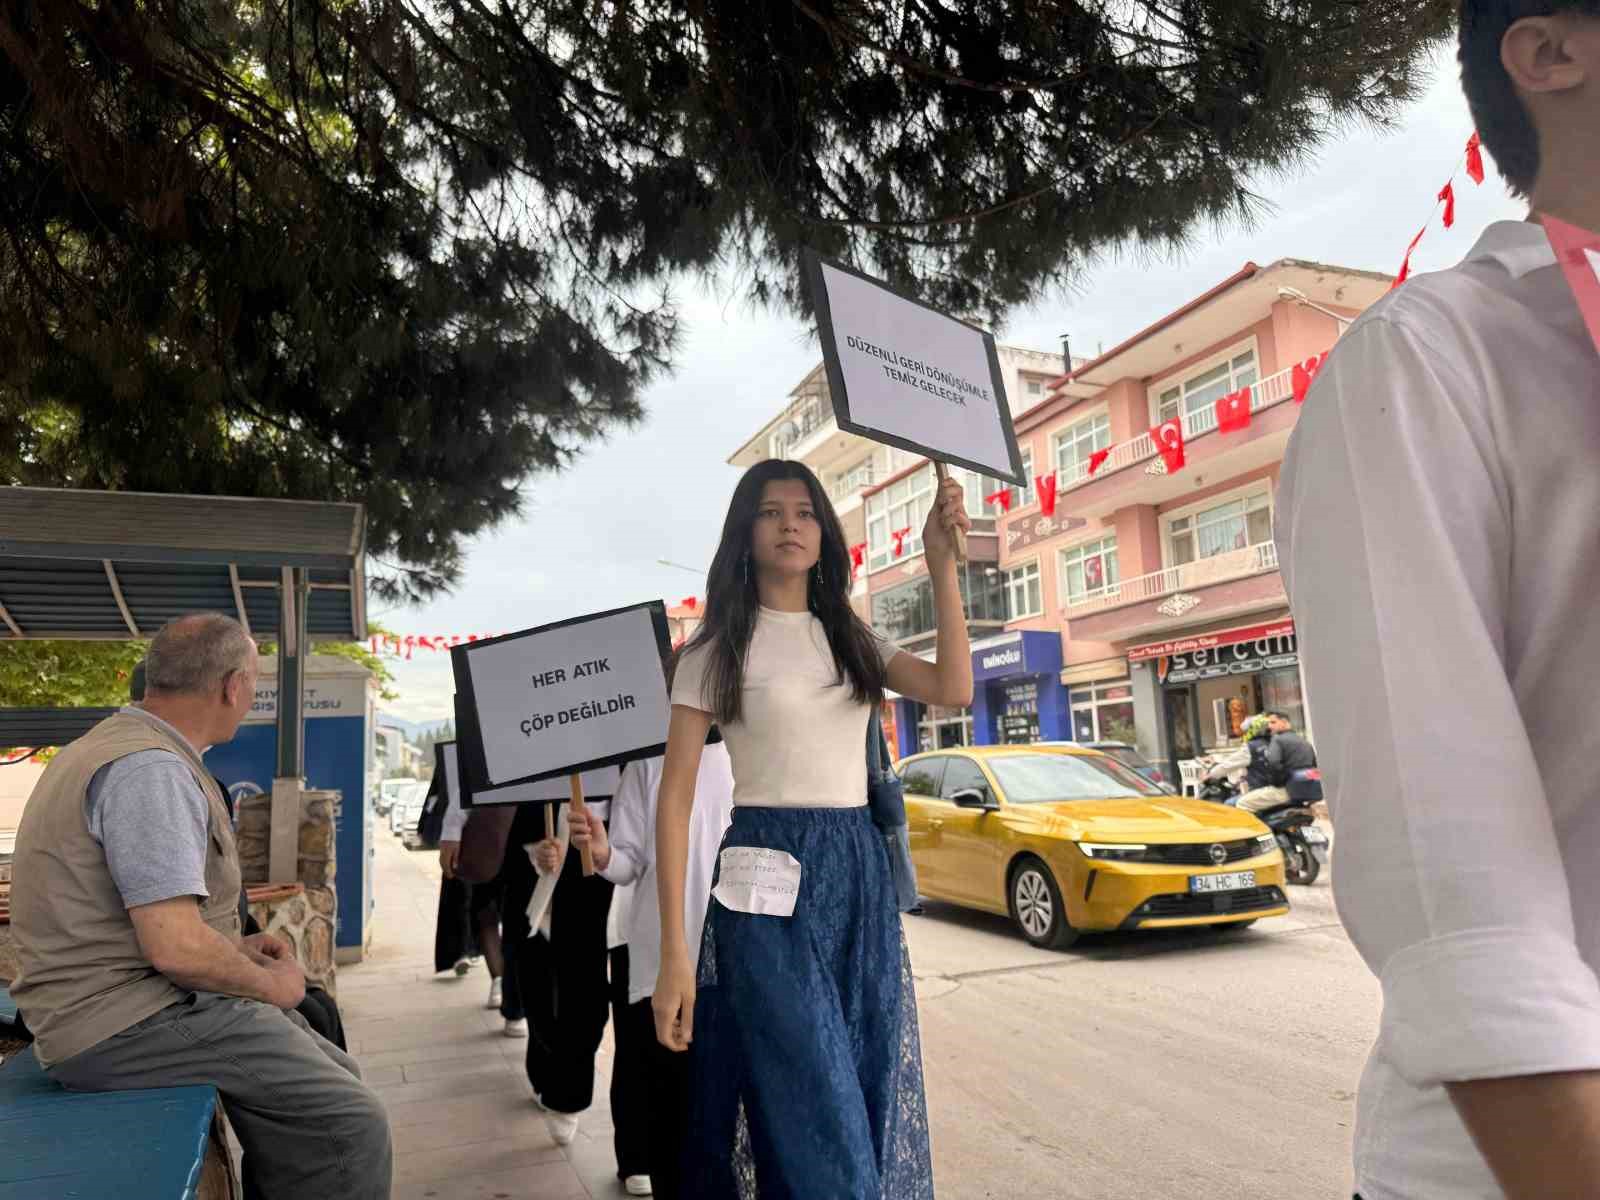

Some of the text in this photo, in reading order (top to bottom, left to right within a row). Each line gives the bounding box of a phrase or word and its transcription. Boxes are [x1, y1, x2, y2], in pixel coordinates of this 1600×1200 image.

[847, 335, 989, 401] DÜZENLİ GERİ DÖNÜŞÜMLE
[883, 365, 967, 407] TEMİZ GELECEK
[532, 658, 611, 689] HER ATIK
[520, 694, 636, 737] ÇÖP DEĞİLDİR
[1197, 877, 1211, 890] 34
